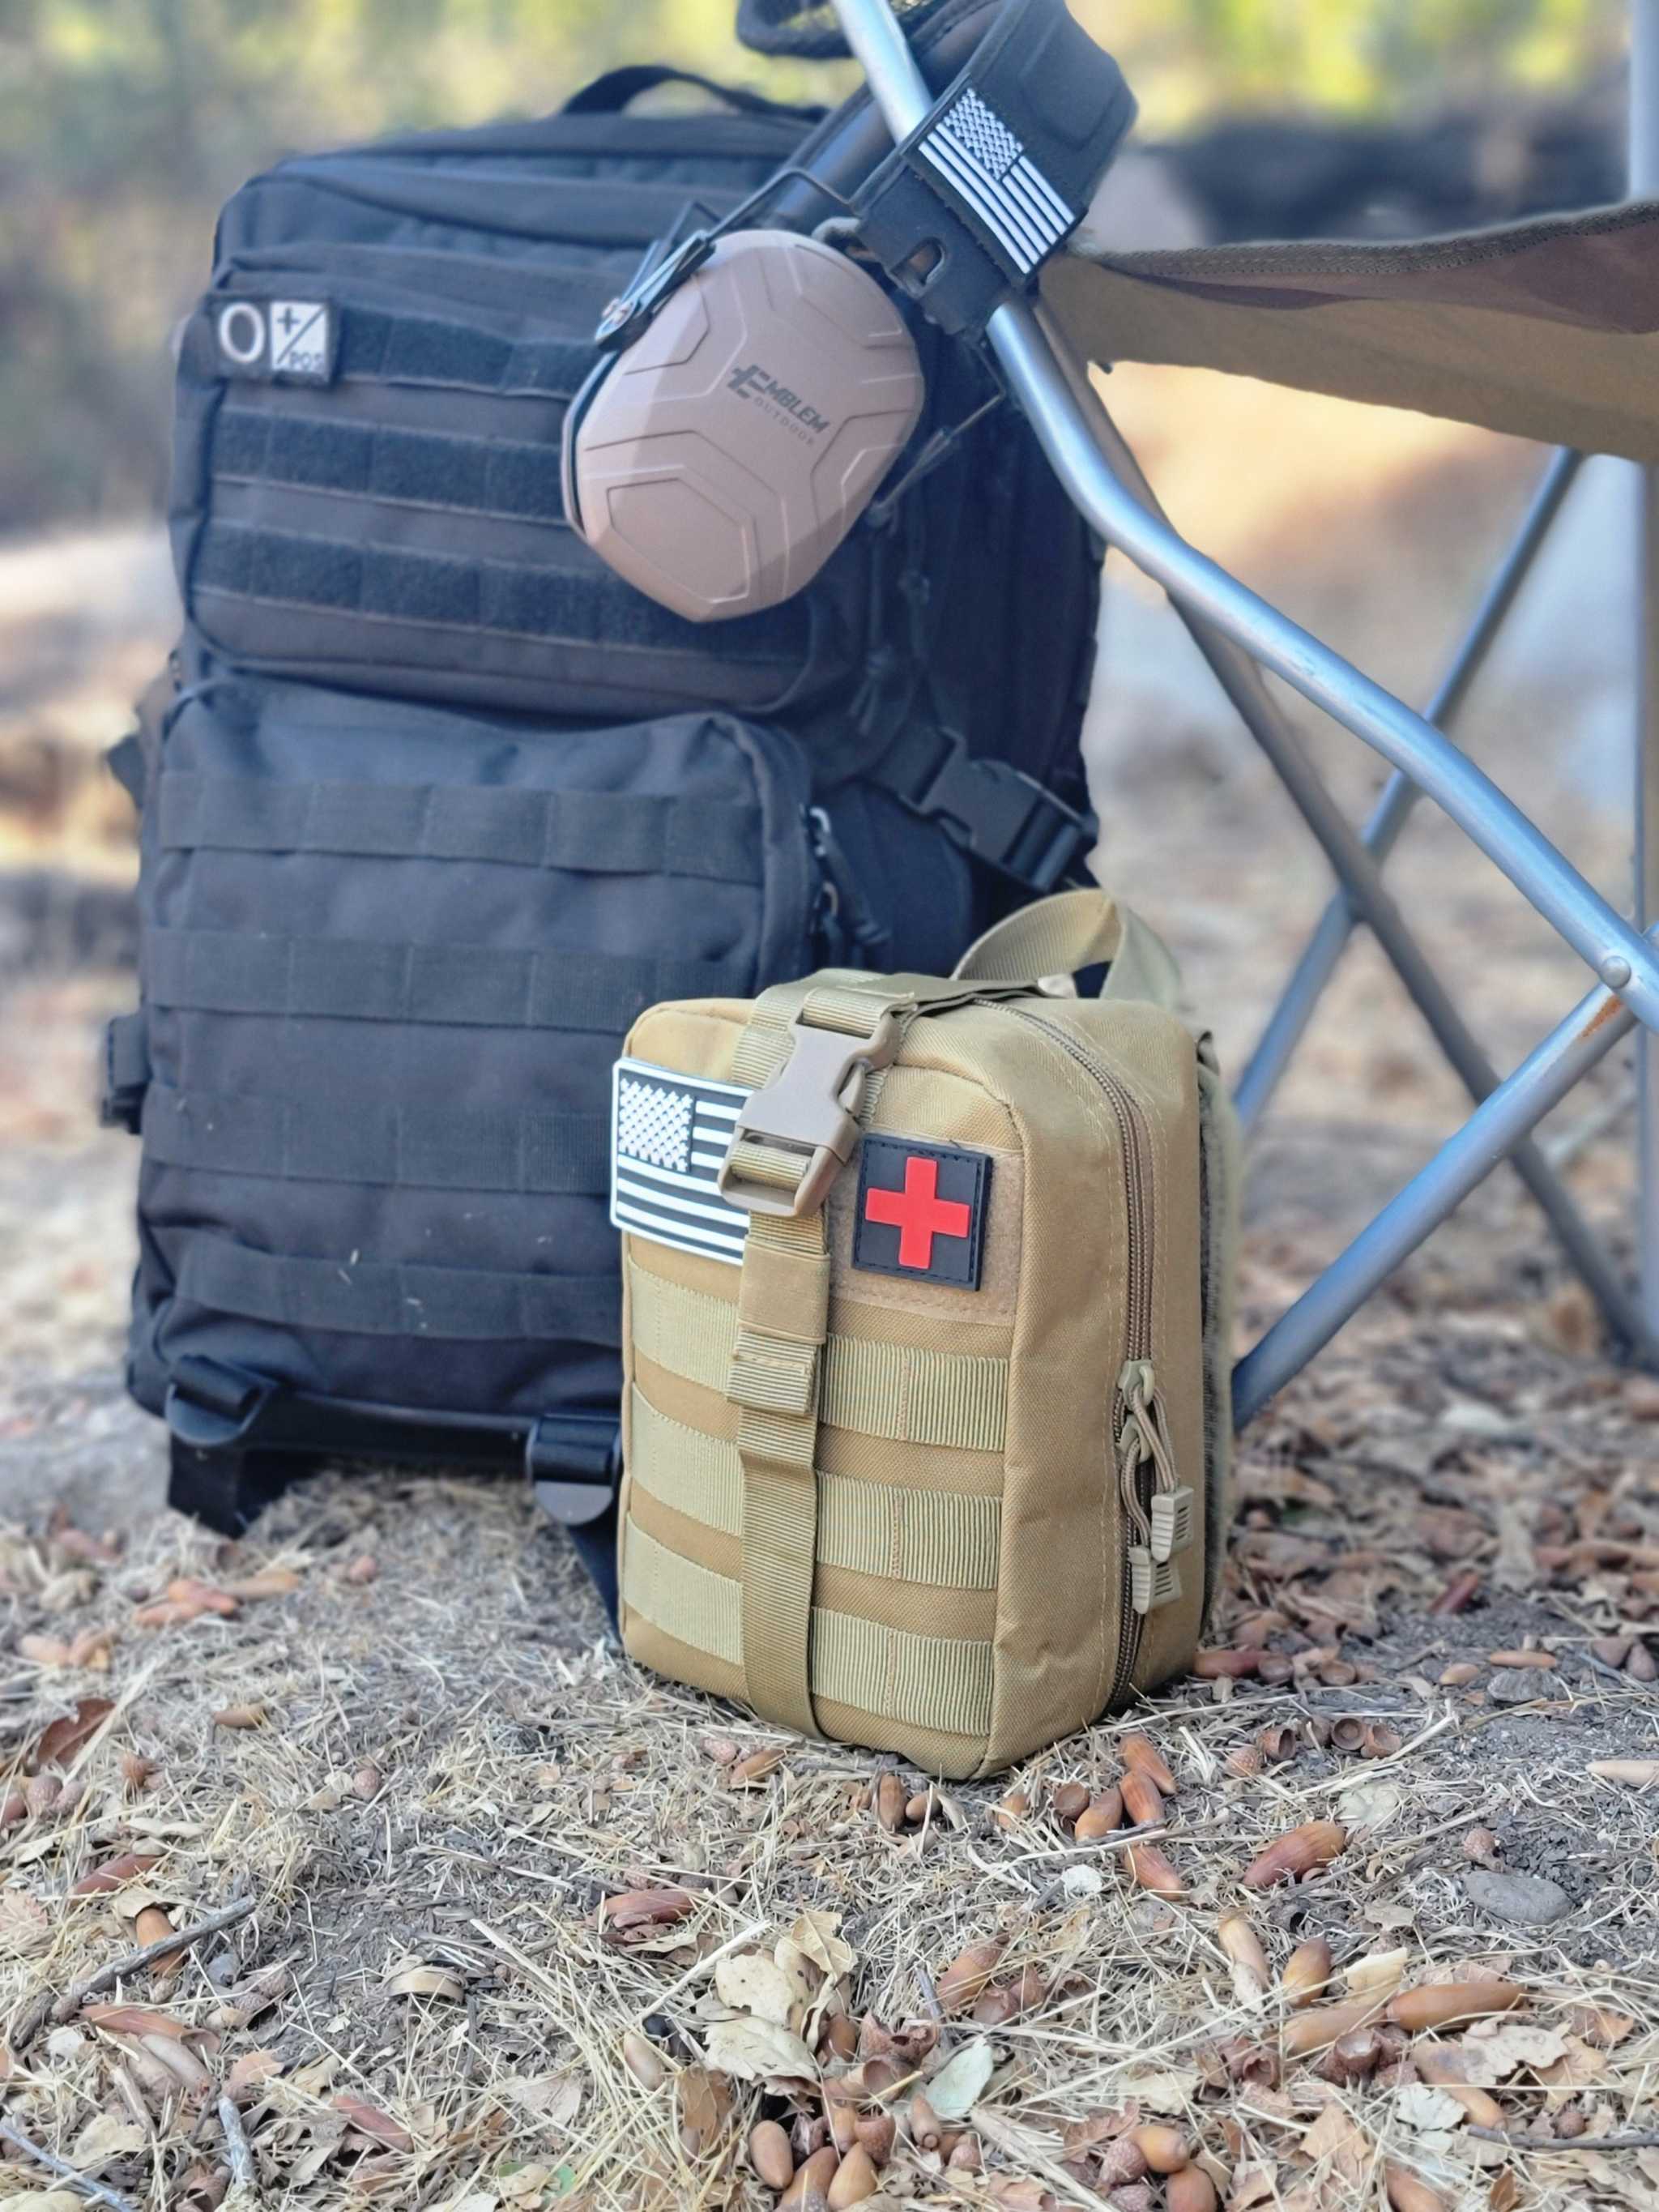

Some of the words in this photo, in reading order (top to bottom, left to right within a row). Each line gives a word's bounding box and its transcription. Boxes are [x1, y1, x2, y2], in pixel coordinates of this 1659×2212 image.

[220, 301, 265, 364] O
[727, 365, 830, 433] EMBLEM
[753, 395, 815, 445] OUTDOOR
